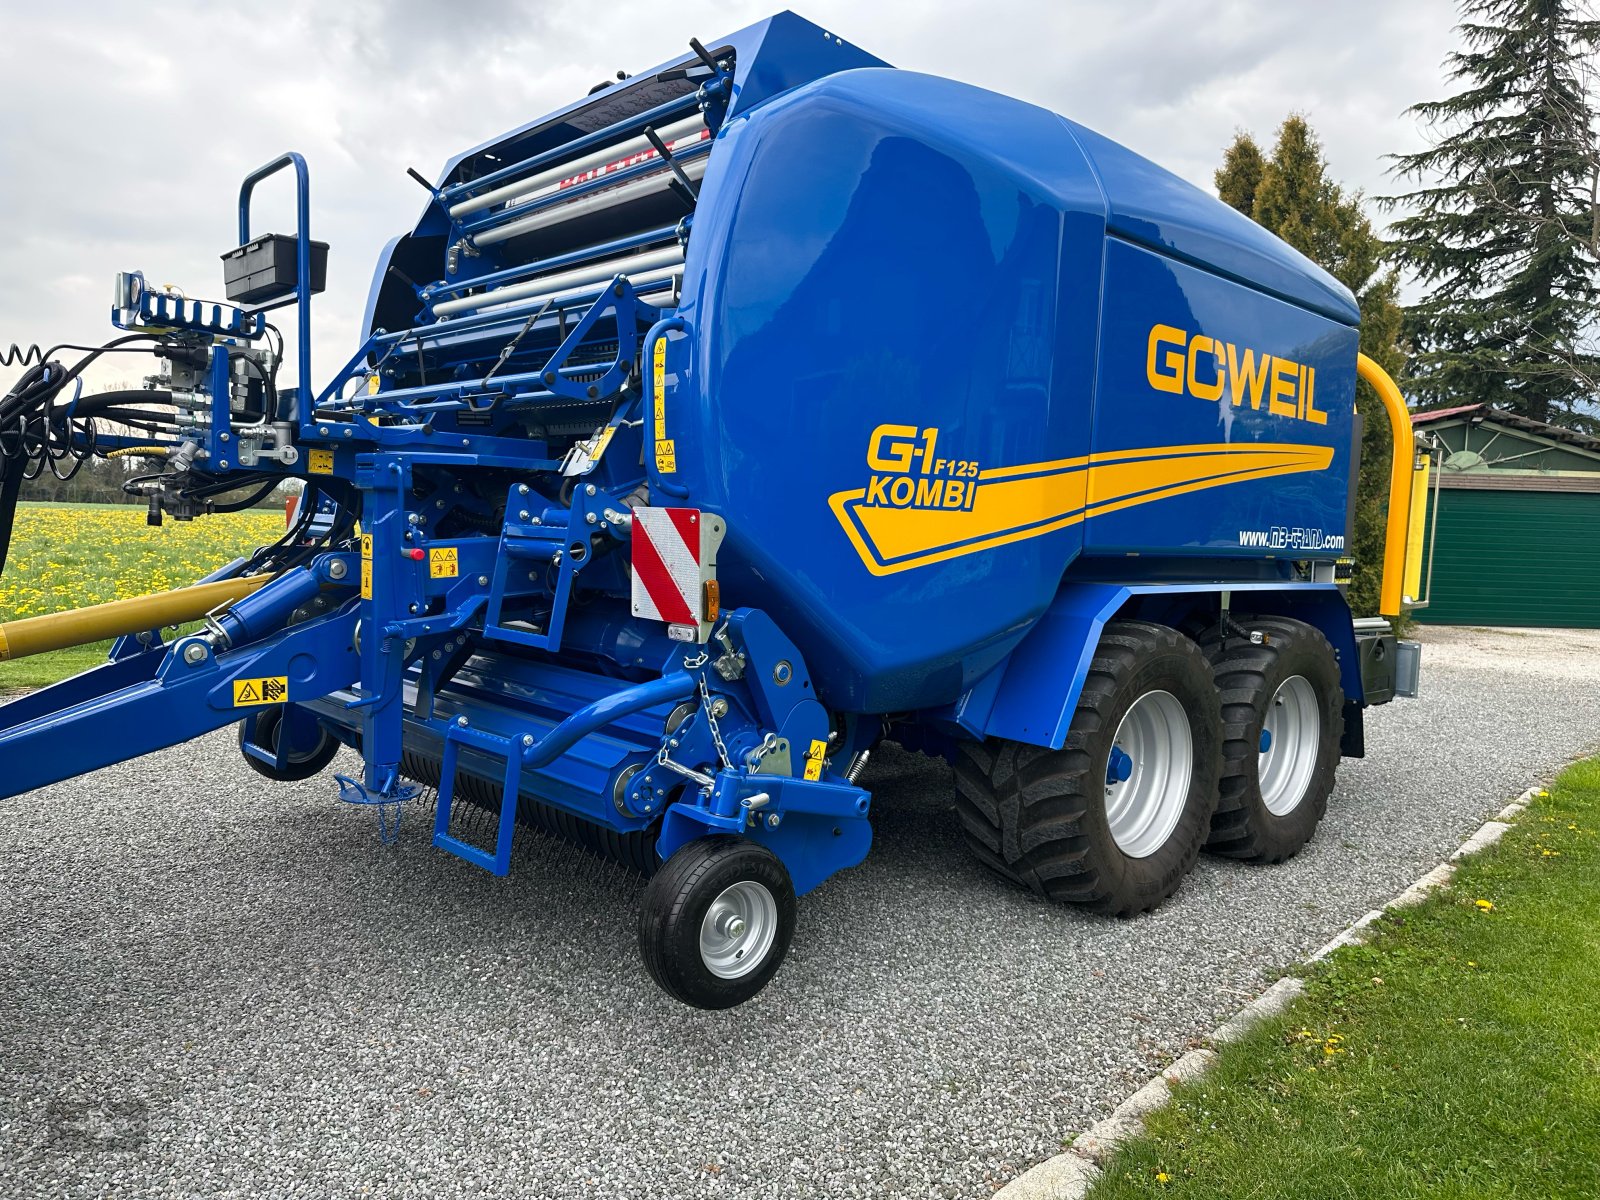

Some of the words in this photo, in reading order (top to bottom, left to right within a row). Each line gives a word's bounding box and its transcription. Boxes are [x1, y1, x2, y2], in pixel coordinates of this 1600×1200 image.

[867, 424, 938, 474] G-1
[934, 459, 978, 477] F125
[866, 476, 975, 508] KOMBI
